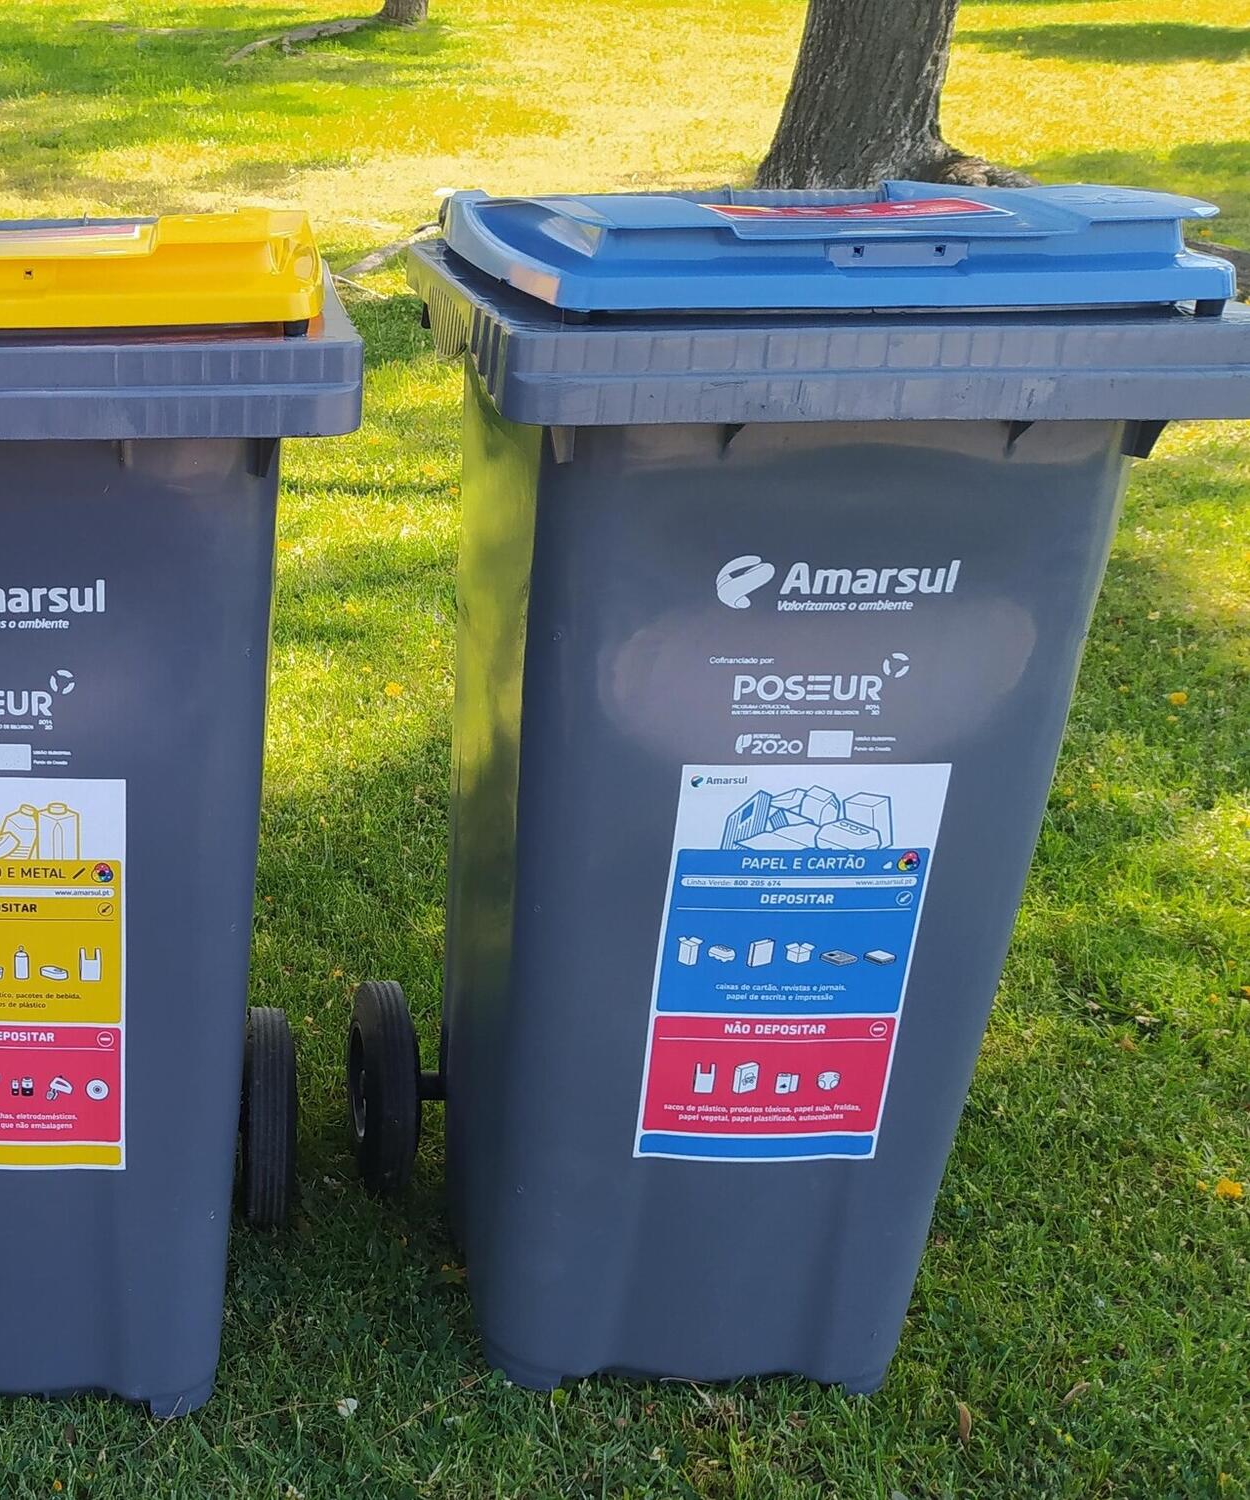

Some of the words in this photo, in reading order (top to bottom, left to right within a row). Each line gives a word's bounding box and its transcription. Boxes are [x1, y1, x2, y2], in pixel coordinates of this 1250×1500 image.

[780, 560, 961, 594] Amarsul
[777, 600, 846, 611] Valorizamos
[859, 600, 913, 610] ambiente
[18, 619, 69, 629] ambiente
[733, 675, 882, 700] POSEUR
[752, 740, 803, 754] 2020
[706, 776, 747, 785] Amarsul
[741, 857, 787, 870] PAPEL
[793, 858, 802, 869] E
[808, 854, 865, 870] CARTÃO
[8, 867, 15, 878] E
[21, 868, 65, 879] METAL
[760, 894, 834, 904] DEPOSITAR
[795, 994, 833, 1002] impressão
[19, 1001, 46, 1010] plástico
[724, 1021, 750, 1034] NÃO
[755, 1024, 825, 1035] DEPOSITAR
[730, 1105, 762, 1114] produtos
[794, 1105, 814, 1114] papel
[679, 1113, 699, 1121] papel
[732, 1114, 751, 1122] papel
[799, 1113, 843, 1121] autocolantes
[0, 1121, 13, 1129] que
[31, 1121, 72, 1130] embalagens
